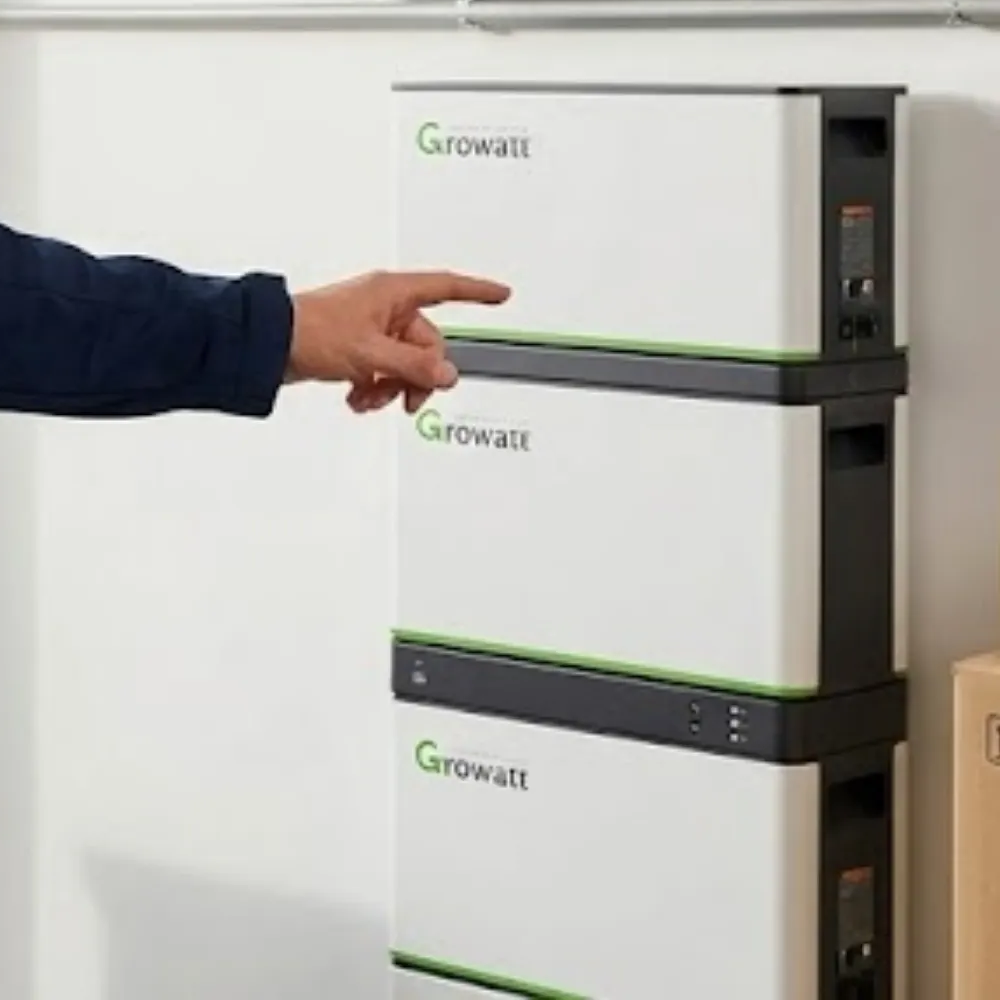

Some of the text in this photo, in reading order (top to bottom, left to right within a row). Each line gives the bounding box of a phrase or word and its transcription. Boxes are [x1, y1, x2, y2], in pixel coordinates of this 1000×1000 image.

[417, 121, 531, 159] Growatt
[416, 408, 531, 452] Growatt
[415, 740, 529, 790] Growatt
